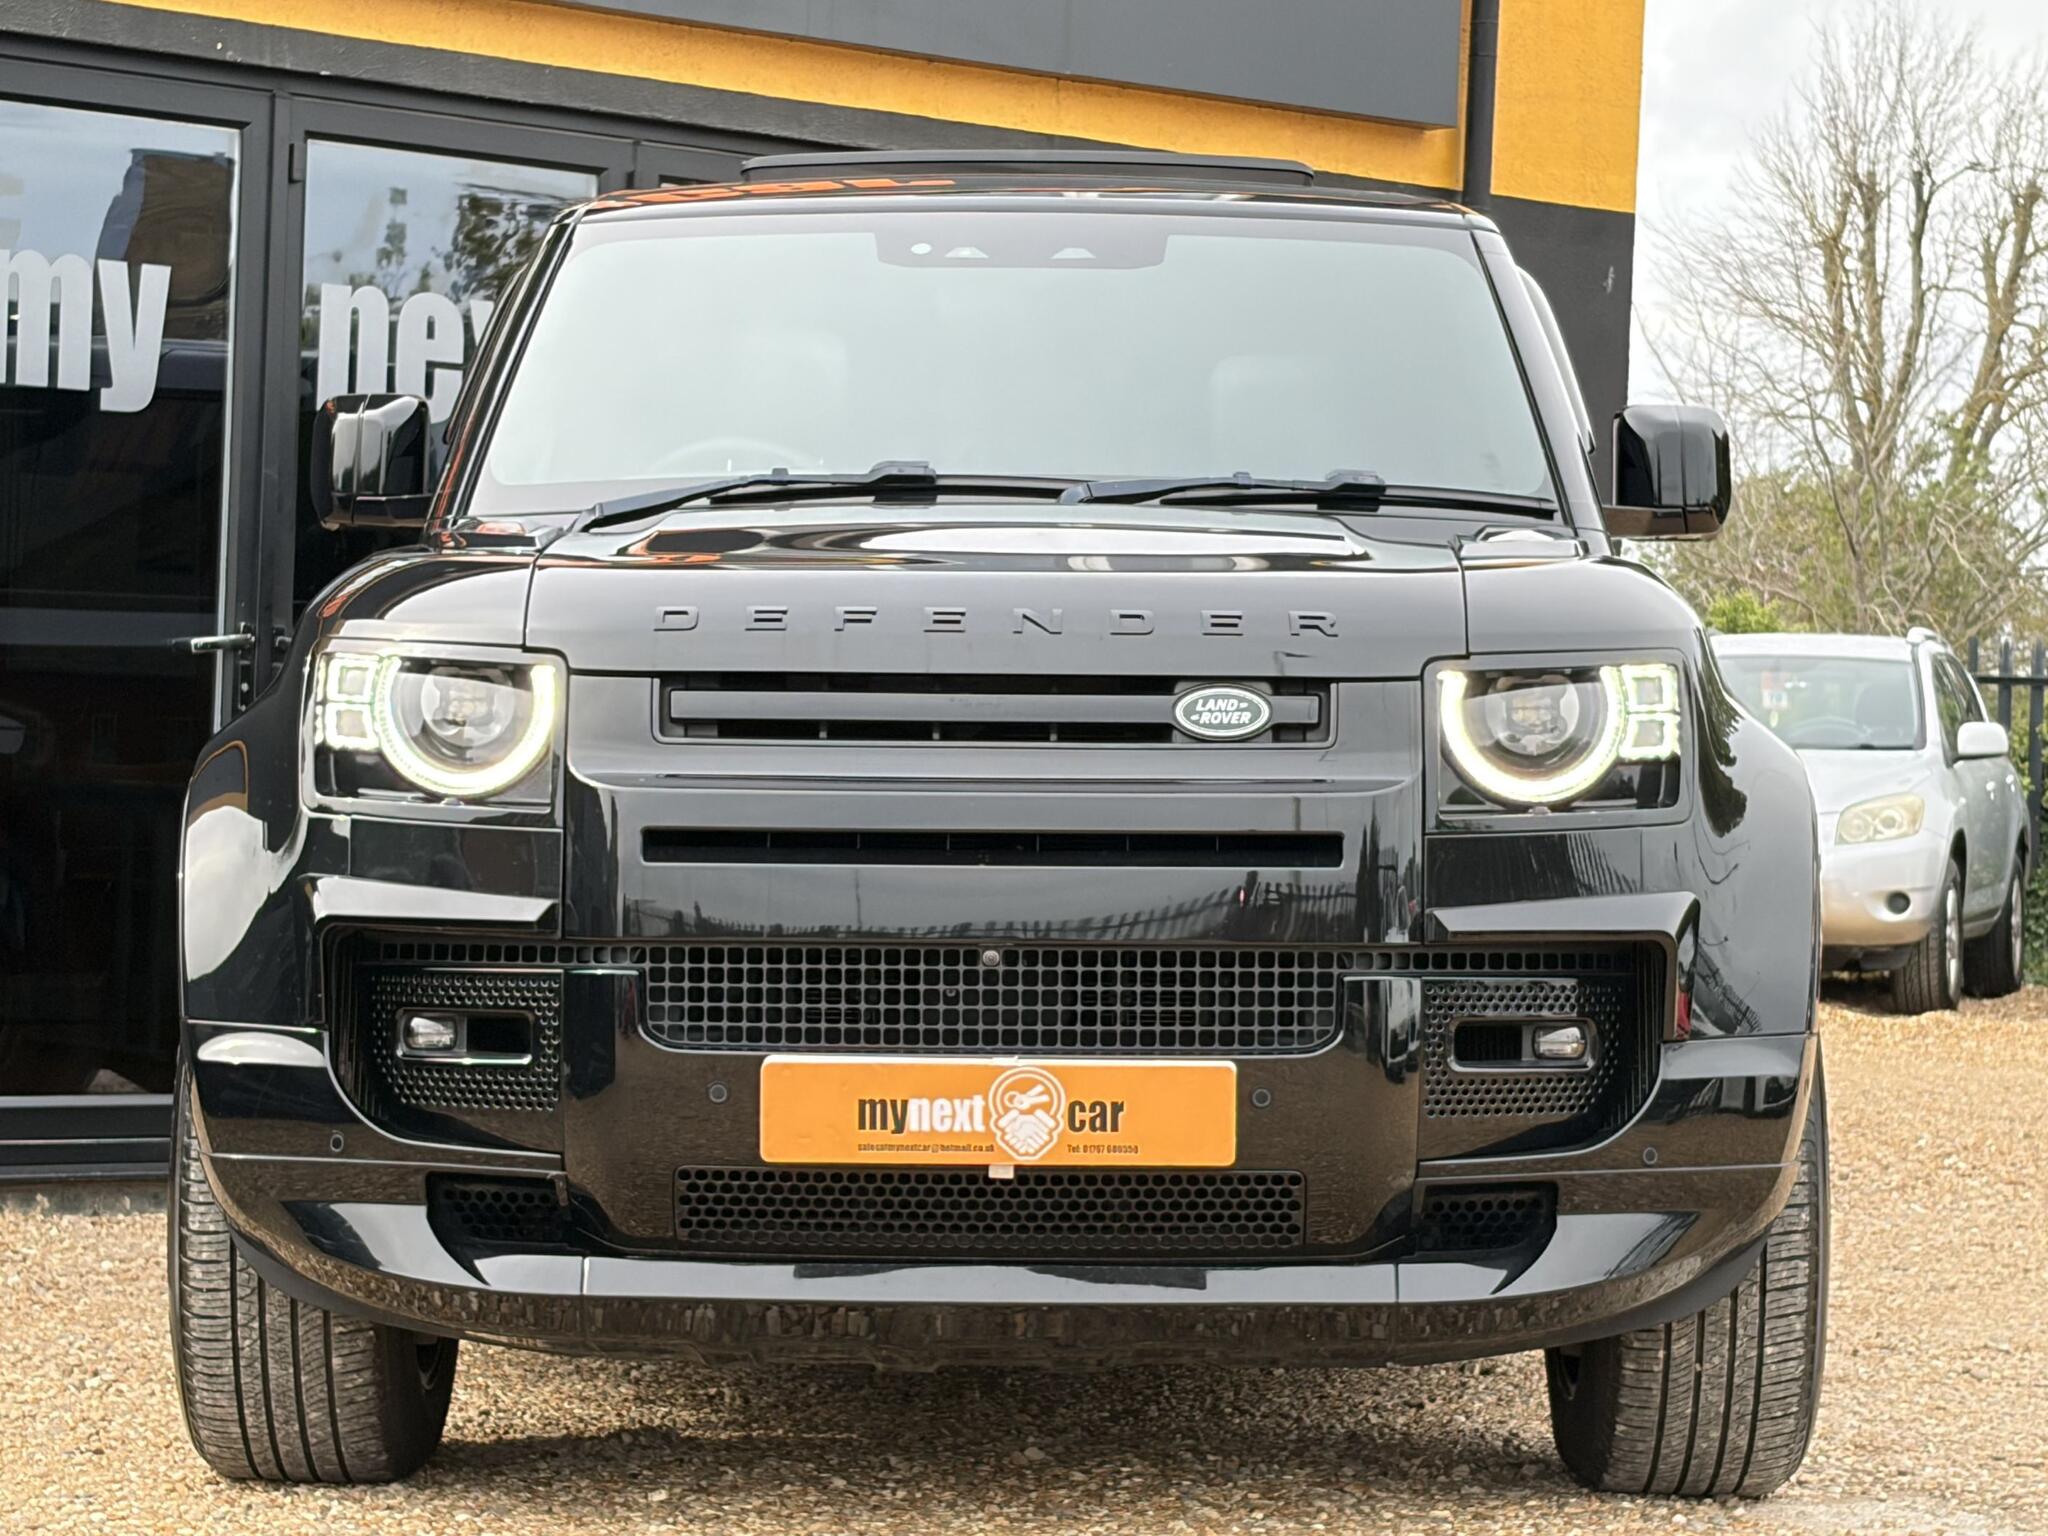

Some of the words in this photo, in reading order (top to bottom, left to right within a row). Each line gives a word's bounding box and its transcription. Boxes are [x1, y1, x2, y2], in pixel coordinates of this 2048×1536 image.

[0, 249, 172, 413] my
[316, 282, 495, 424] ne
[653, 604, 1339, 638] DEFENDER
[1068, 1100, 1124, 1133] car
